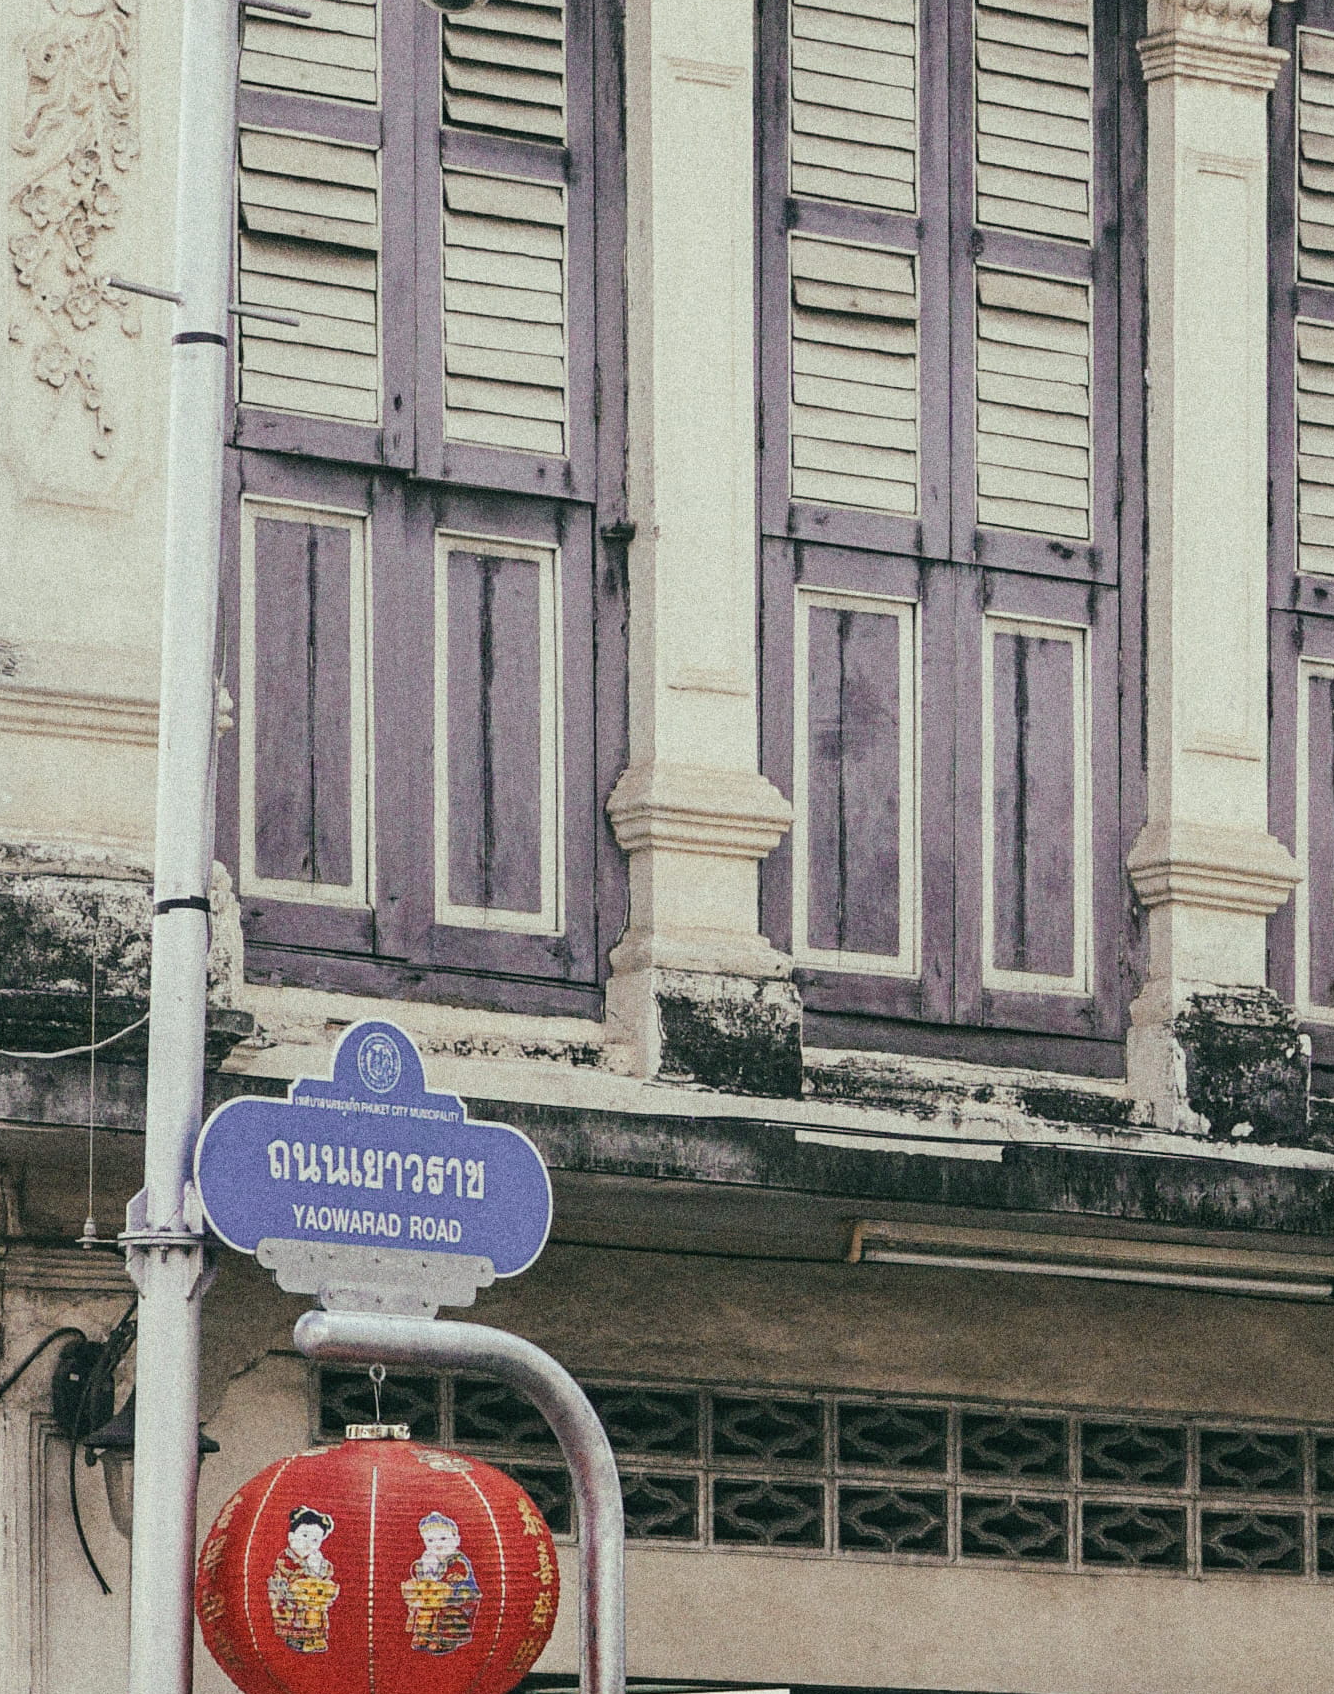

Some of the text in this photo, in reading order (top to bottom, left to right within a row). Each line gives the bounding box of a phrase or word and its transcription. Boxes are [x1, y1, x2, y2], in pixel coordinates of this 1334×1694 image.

[360, 1101, 390, 1116] PHUKET
[391, 1104, 408, 1117] CITY
[409, 1107, 460, 1122] MUNICIPALITY
[267, 1139, 486, 1200] ถนนเยาวราช
[292, 1203, 462, 1244] YAOWARAD ROAD
